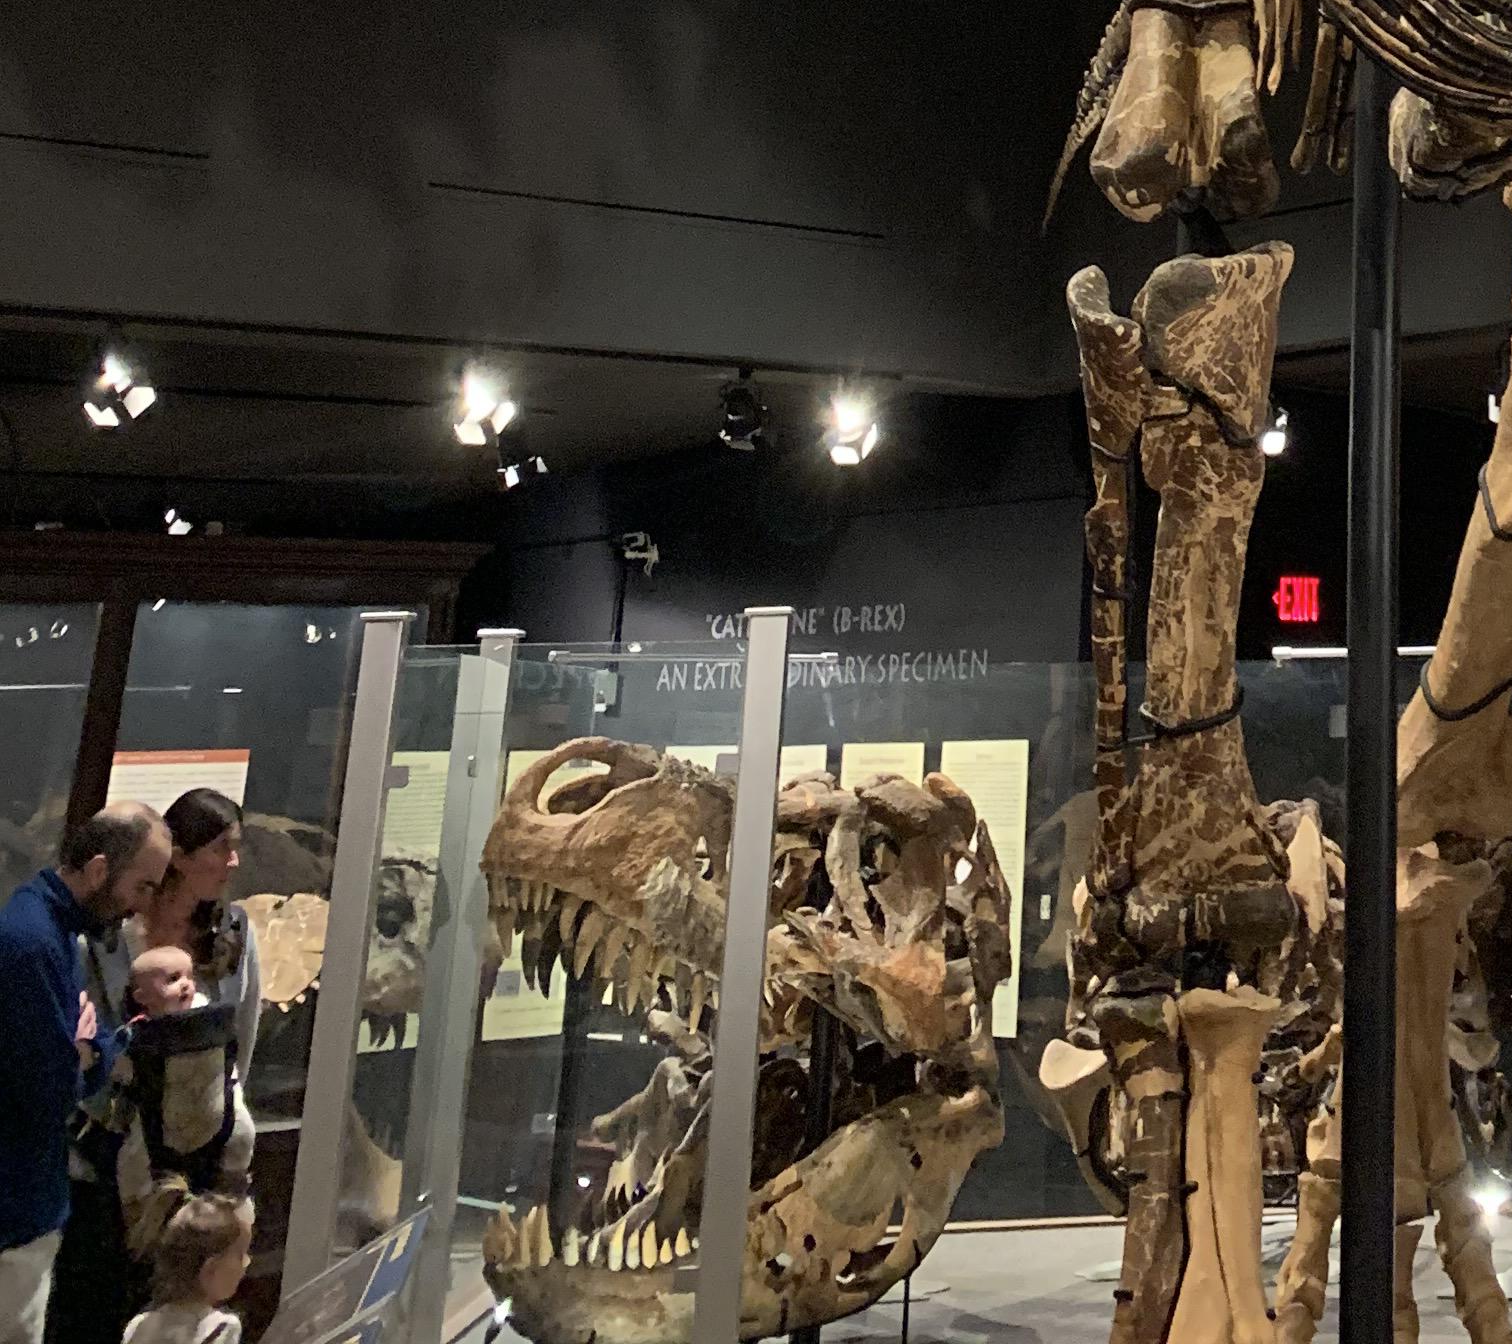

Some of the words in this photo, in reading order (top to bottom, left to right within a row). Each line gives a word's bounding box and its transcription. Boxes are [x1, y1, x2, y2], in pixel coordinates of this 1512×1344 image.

[1279, 577, 1319, 622] EXIT
[706, 608, 825, 640] "CATNE"
[833, 603, 905, 634] (B-REX)
[656, 663, 687, 692] AN
[694, 654, 873, 691] EXTRDINARY
[876, 650, 988, 684] SPECIMEN
